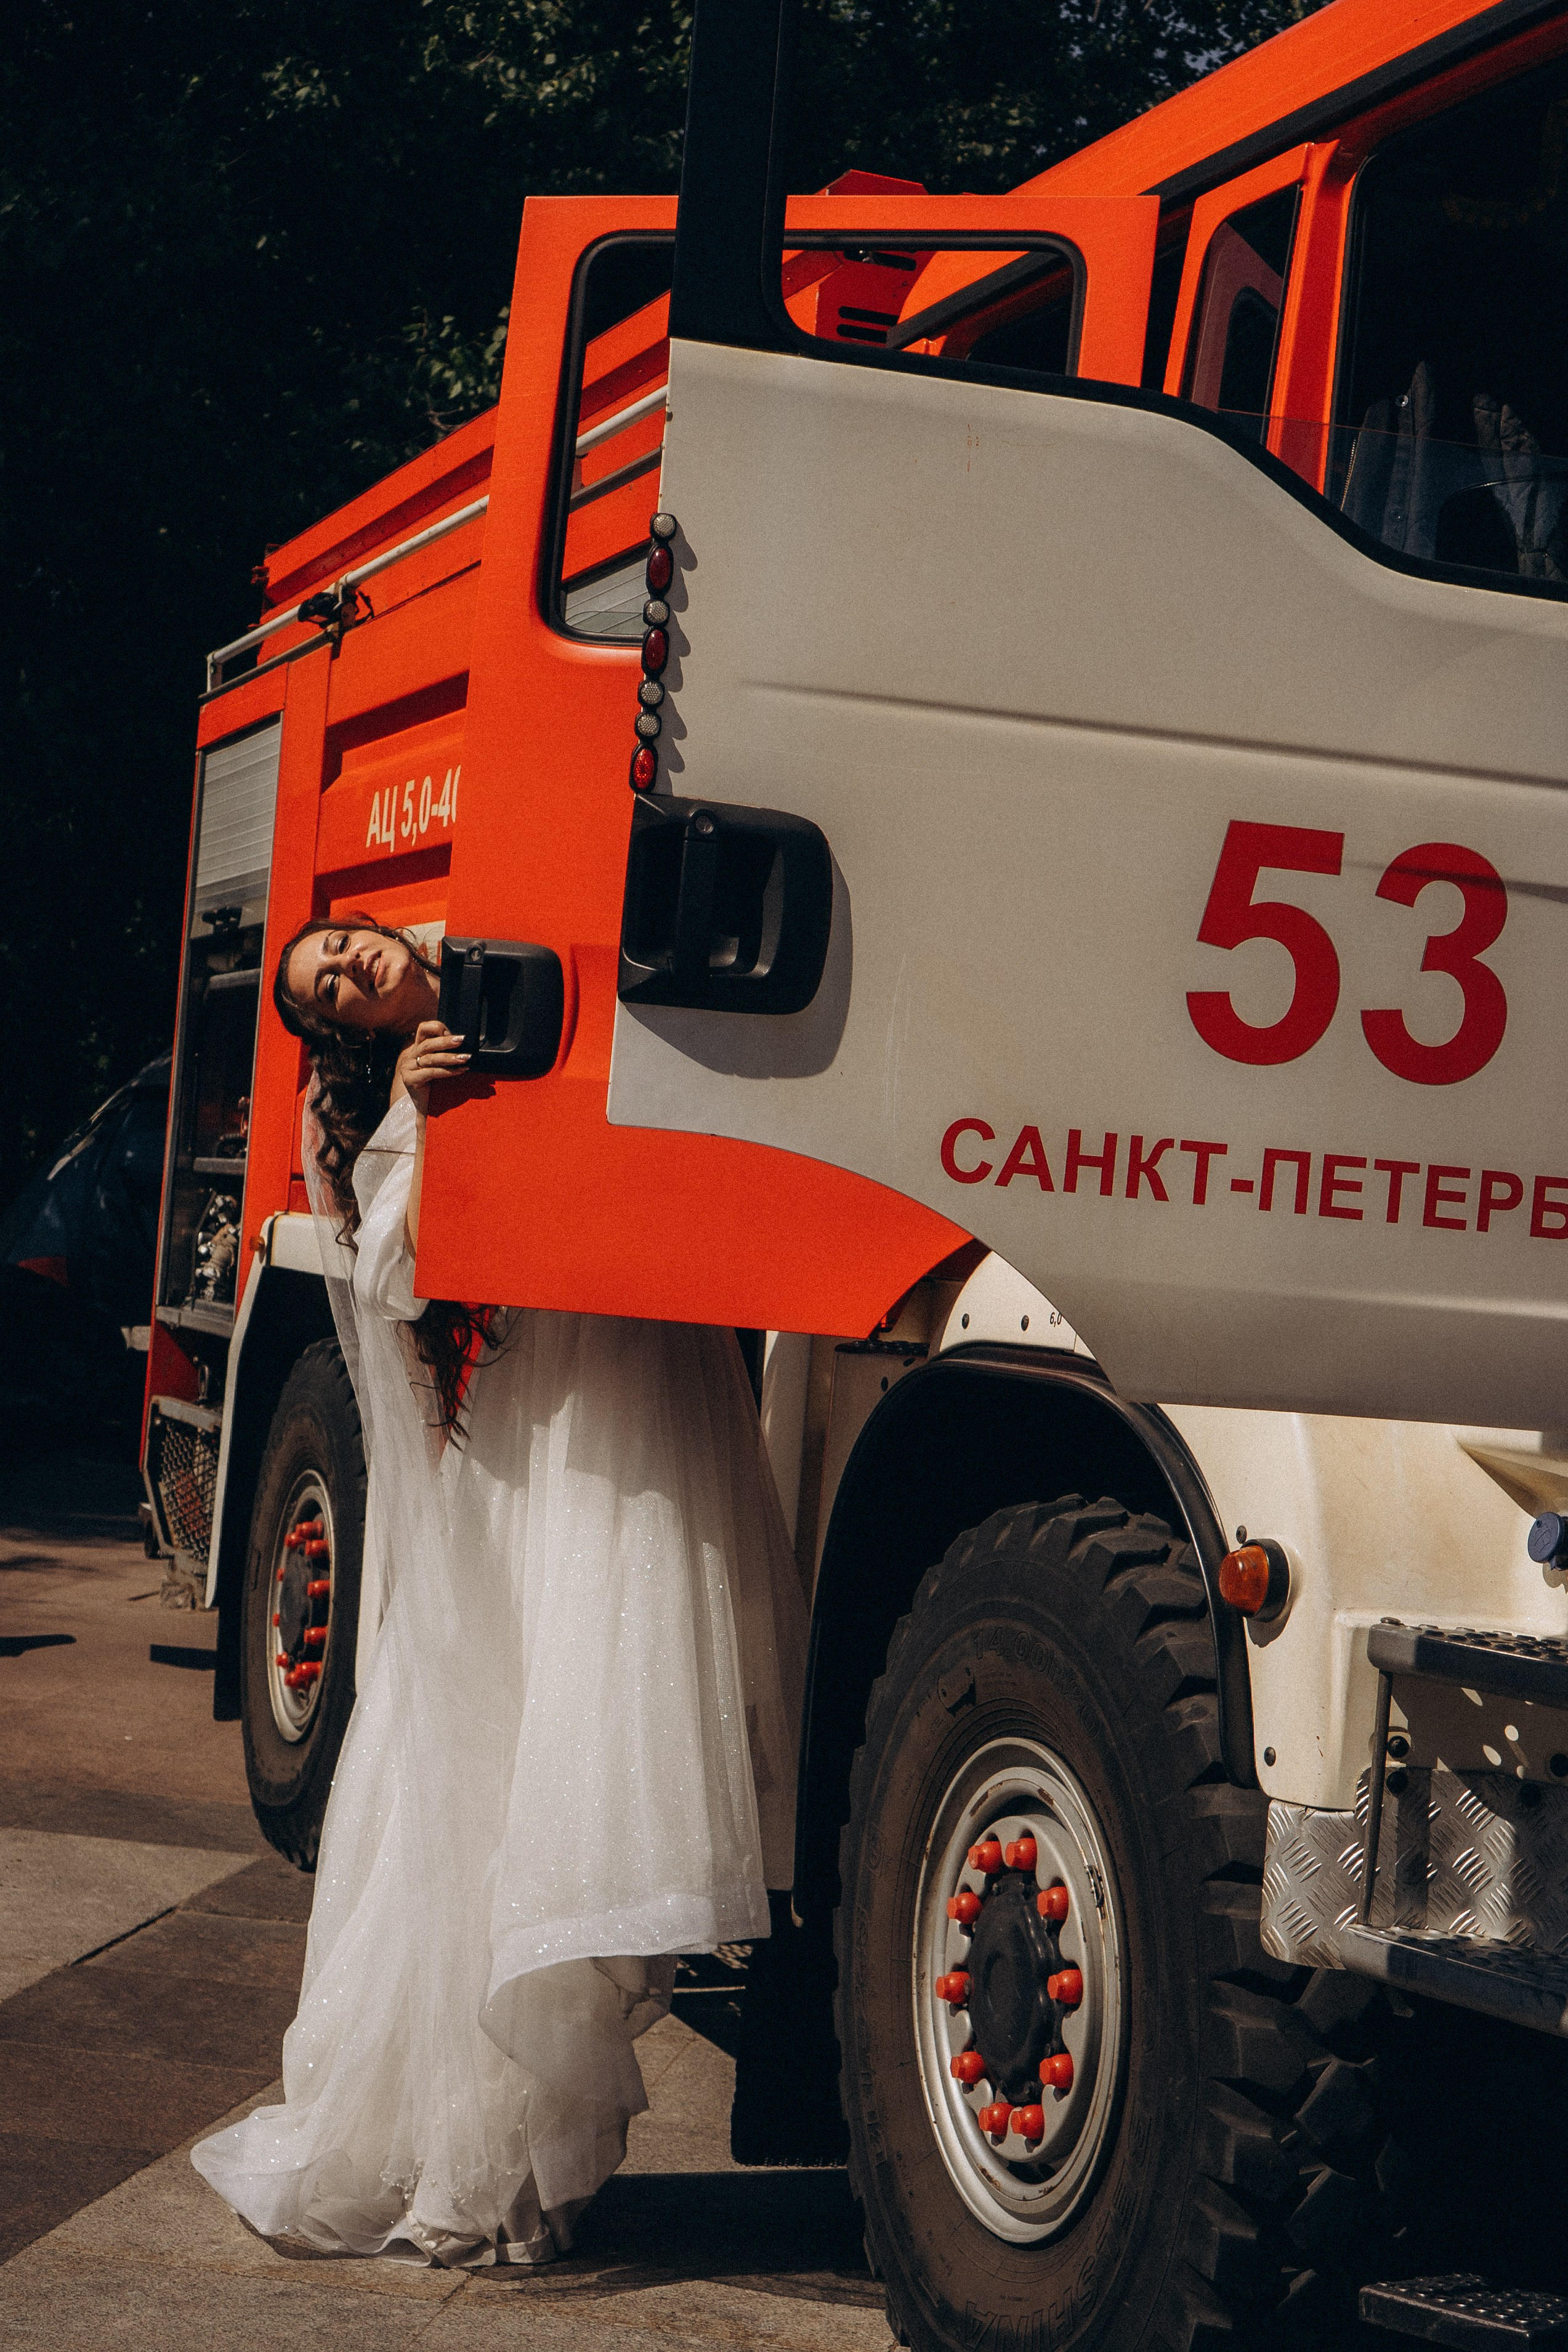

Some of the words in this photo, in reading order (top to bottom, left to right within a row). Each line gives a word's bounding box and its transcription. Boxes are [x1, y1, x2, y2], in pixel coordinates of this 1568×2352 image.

[366, 785, 398, 853] АЦ
[1186, 820, 1507, 1085] 53
[940, 1117, 1568, 1240] САНКТ-ПЕТЕРБ
